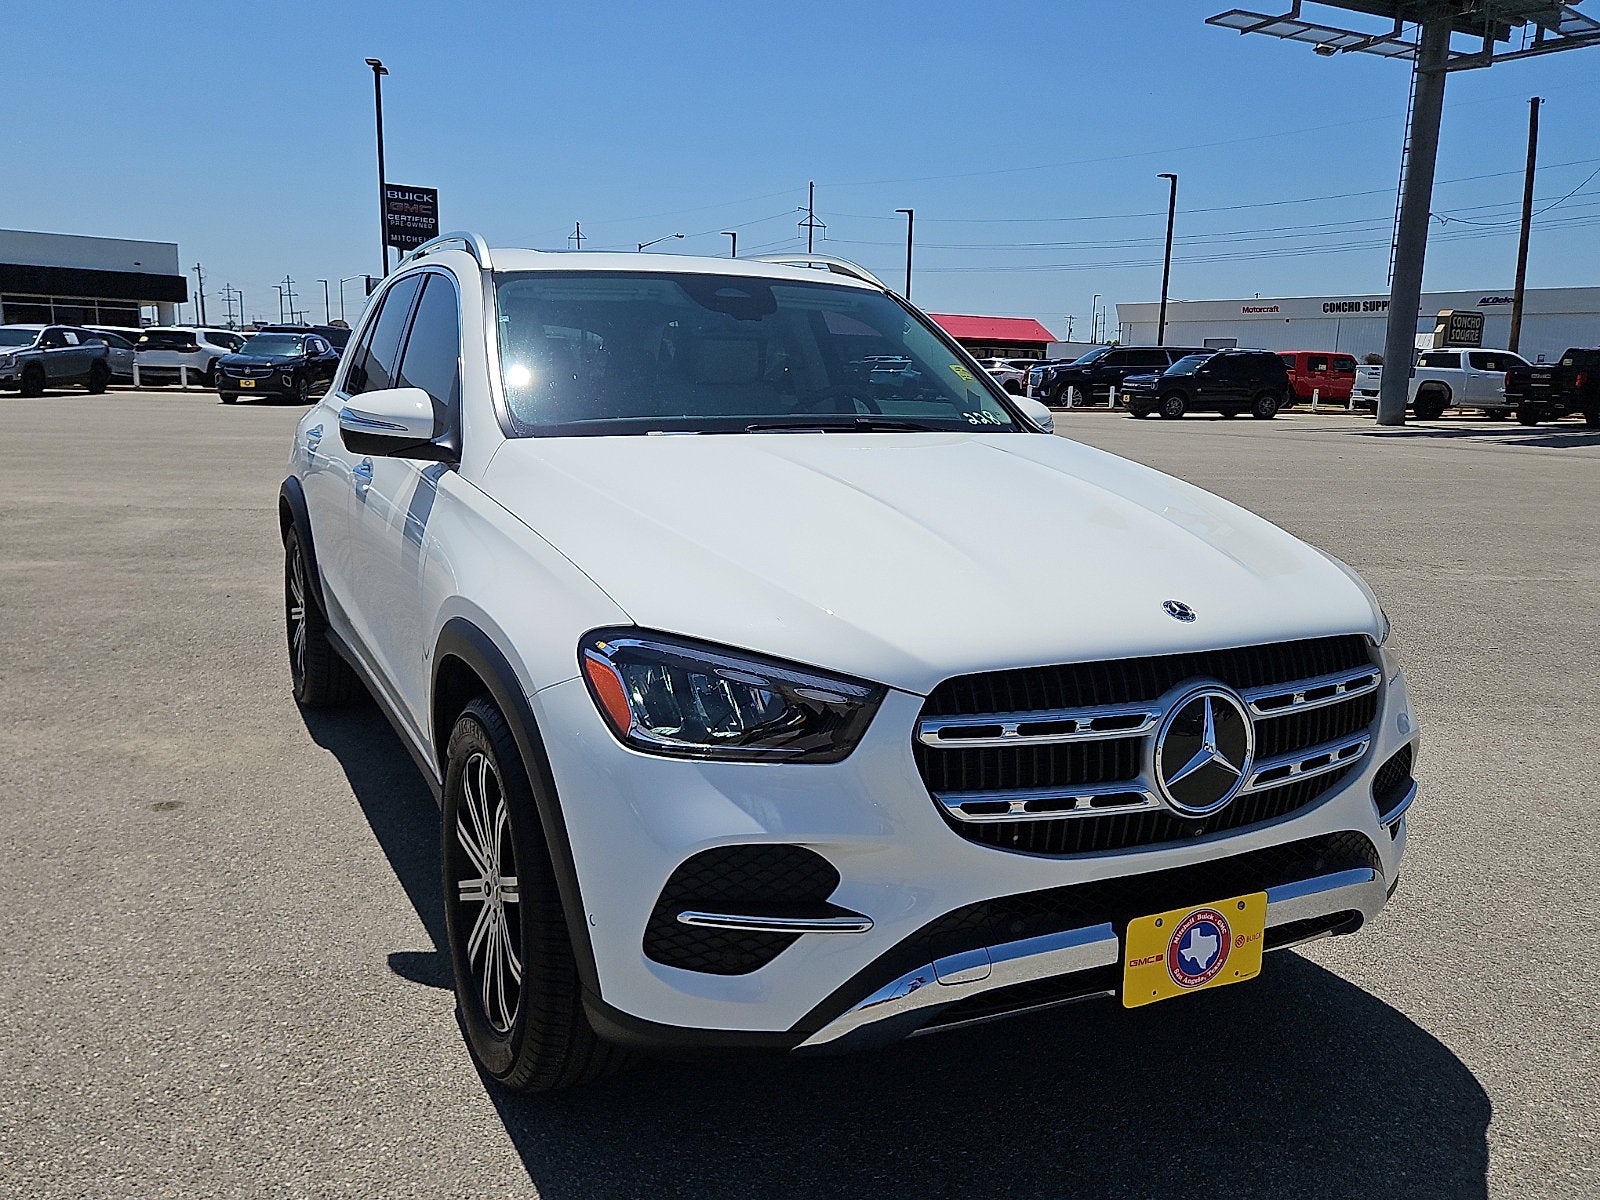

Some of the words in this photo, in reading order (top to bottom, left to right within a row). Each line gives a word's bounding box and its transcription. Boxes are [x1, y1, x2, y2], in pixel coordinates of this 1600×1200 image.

[387, 191, 433, 203] BUICK
[390, 202, 432, 213] GMC
[388, 214, 436, 224] CERTIFIED
[390, 220, 433, 229] PRE-OWNED
[391, 234, 431, 243] MITCHEL
[1242, 305, 1280, 313] Motorcraft
[1322, 301, 1361, 314] CONCHO
[1452, 316, 1480, 329] CONCHO
[1450, 328, 1479, 341] SQUARE
[962, 410, 1001, 426] 228
[1173, 917, 1195, 944] Mitchell
[1196, 913, 1214, 921] Buick
[1216, 919, 1228, 935] GMC
[1129, 956, 1155, 968] GMC
[1173, 968, 1183, 980] San
[1206, 958, 1223, 977] Texas
